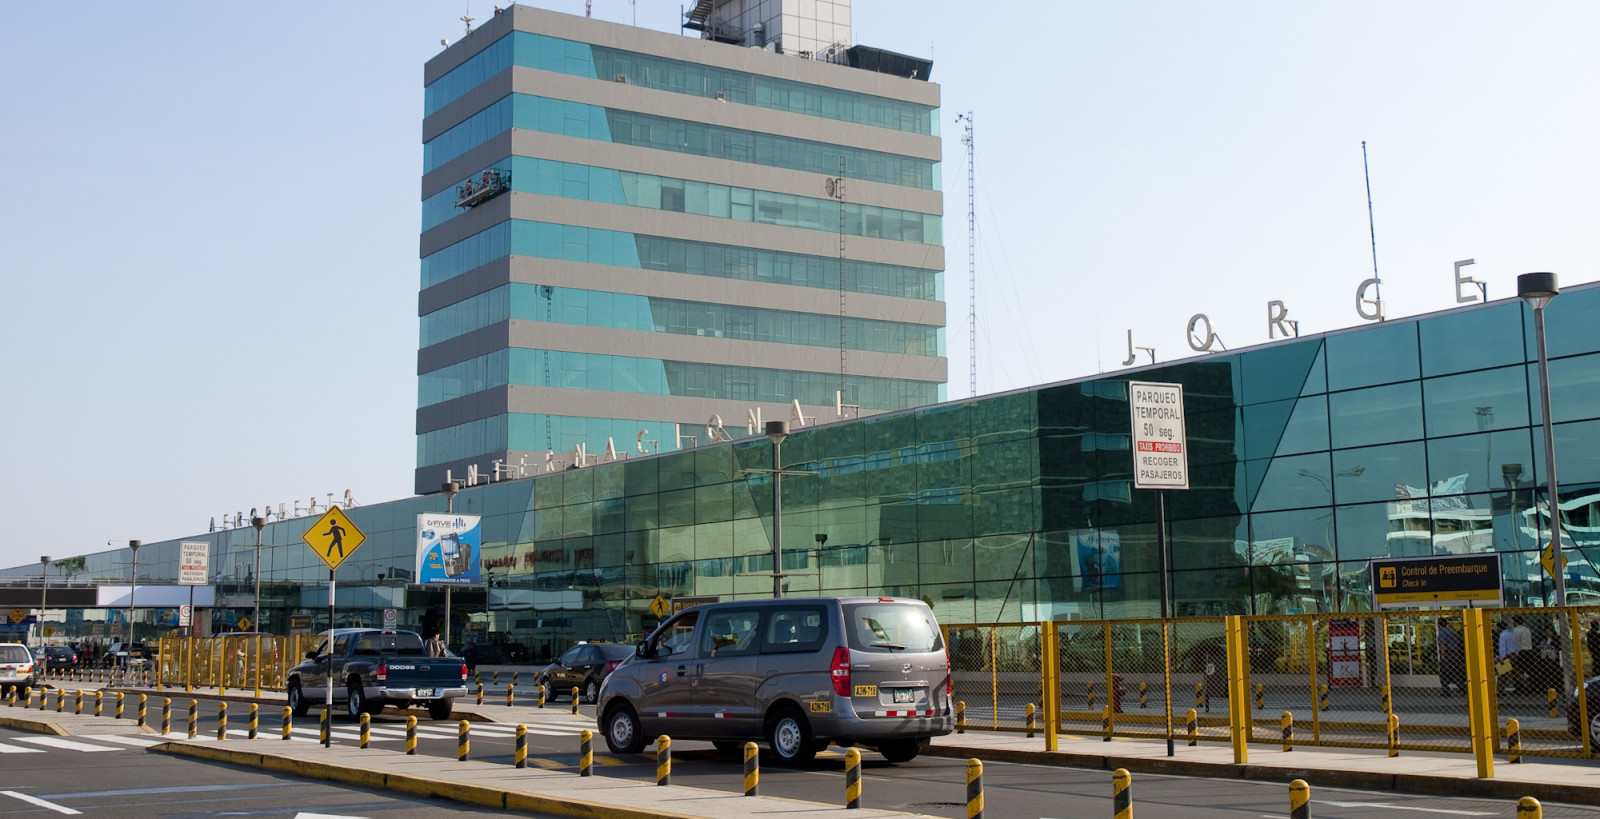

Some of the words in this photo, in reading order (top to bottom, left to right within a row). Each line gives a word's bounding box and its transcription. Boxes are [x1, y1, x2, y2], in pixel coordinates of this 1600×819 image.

[1122, 258, 1481, 366] JORGE
[1136, 391, 1176, 404] PARQUEO
[1136, 407, 1180, 420] TEMPORAL
[446, 389, 849, 487] INTERNACIONAL
[1143, 423, 1154, 437] 50
[1159, 427, 1175, 441] seg.
[1139, 442, 1153, 452] TAXIS
[1155, 442, 1181, 453] PROHIBIDO
[1142, 456, 1178, 467] RECOGER
[1140, 469, 1182, 480] PASAJEROS
[1401, 565, 1427, 577] Control
[1428, 566, 1438, 575] de
[1439, 564, 1488, 575] Preembarque
[1402, 580, 1419, 588] Check
